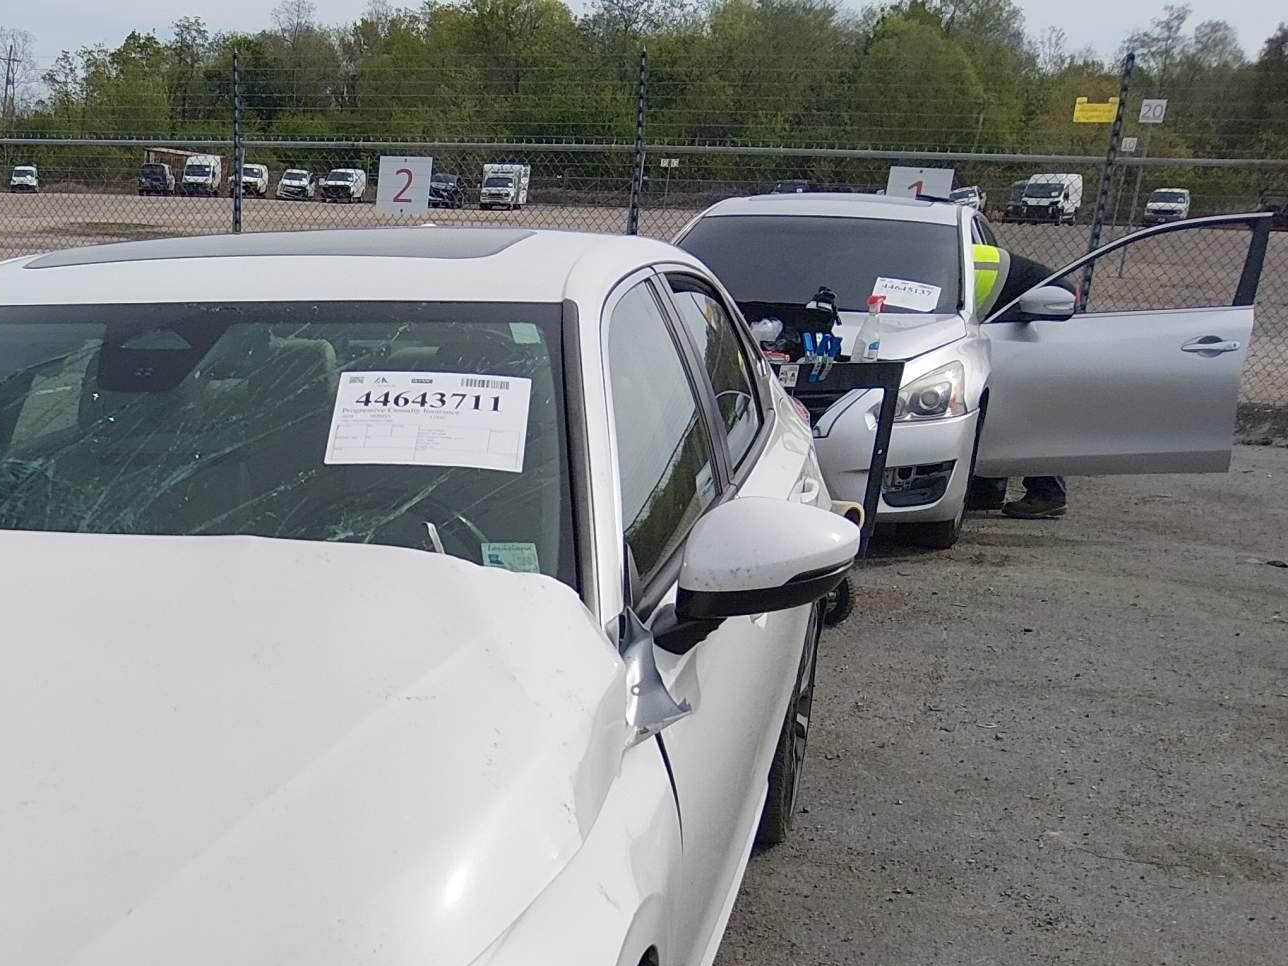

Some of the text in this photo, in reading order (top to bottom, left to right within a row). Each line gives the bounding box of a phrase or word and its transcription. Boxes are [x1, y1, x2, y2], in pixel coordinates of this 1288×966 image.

[1142, 104, 1164, 119] 20
[393, 169, 412, 202] 2
[355, 390, 503, 412] 44643711
